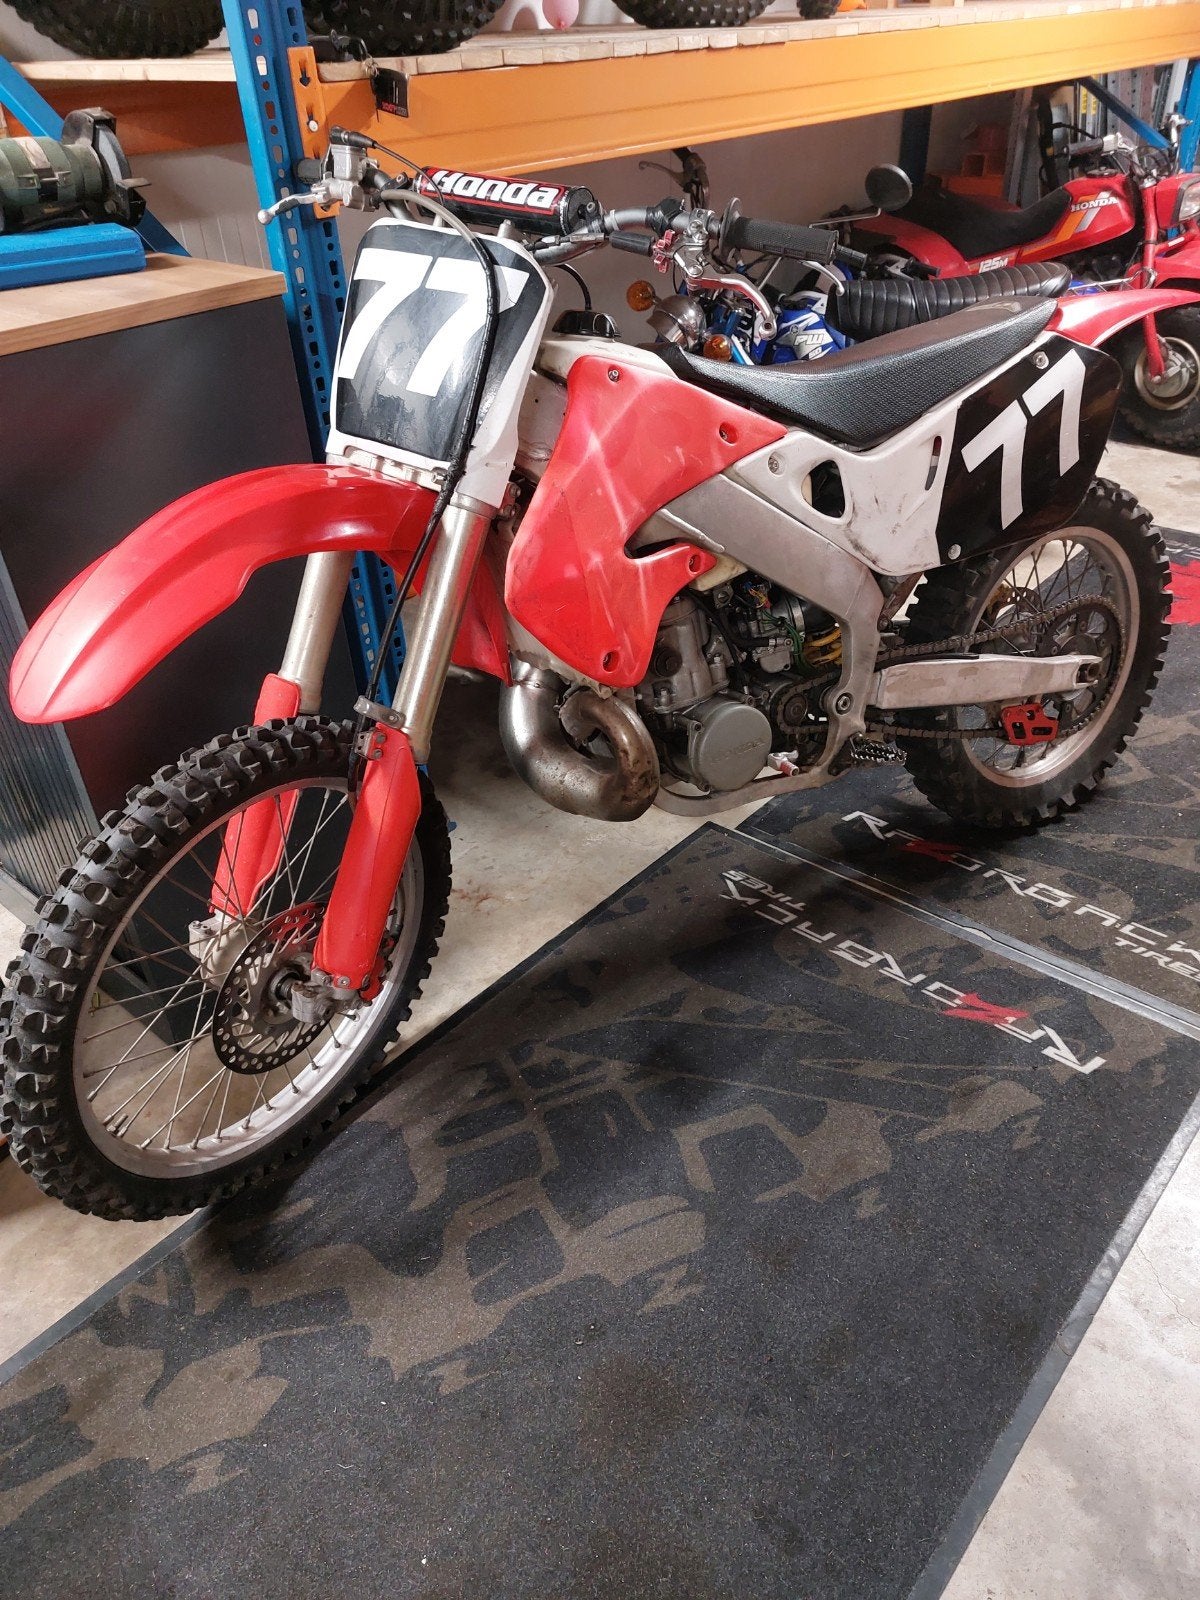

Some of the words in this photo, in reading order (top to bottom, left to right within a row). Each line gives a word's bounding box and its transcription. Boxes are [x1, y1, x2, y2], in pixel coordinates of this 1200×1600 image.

[426, 170, 559, 209] Honda
[1071, 196, 1119, 212] HONDA
[337, 247, 530, 398] 77
[793, 333, 824, 346] PW
[960, 348, 1087, 531] 77
[721, 870, 807, 911] TIRES
